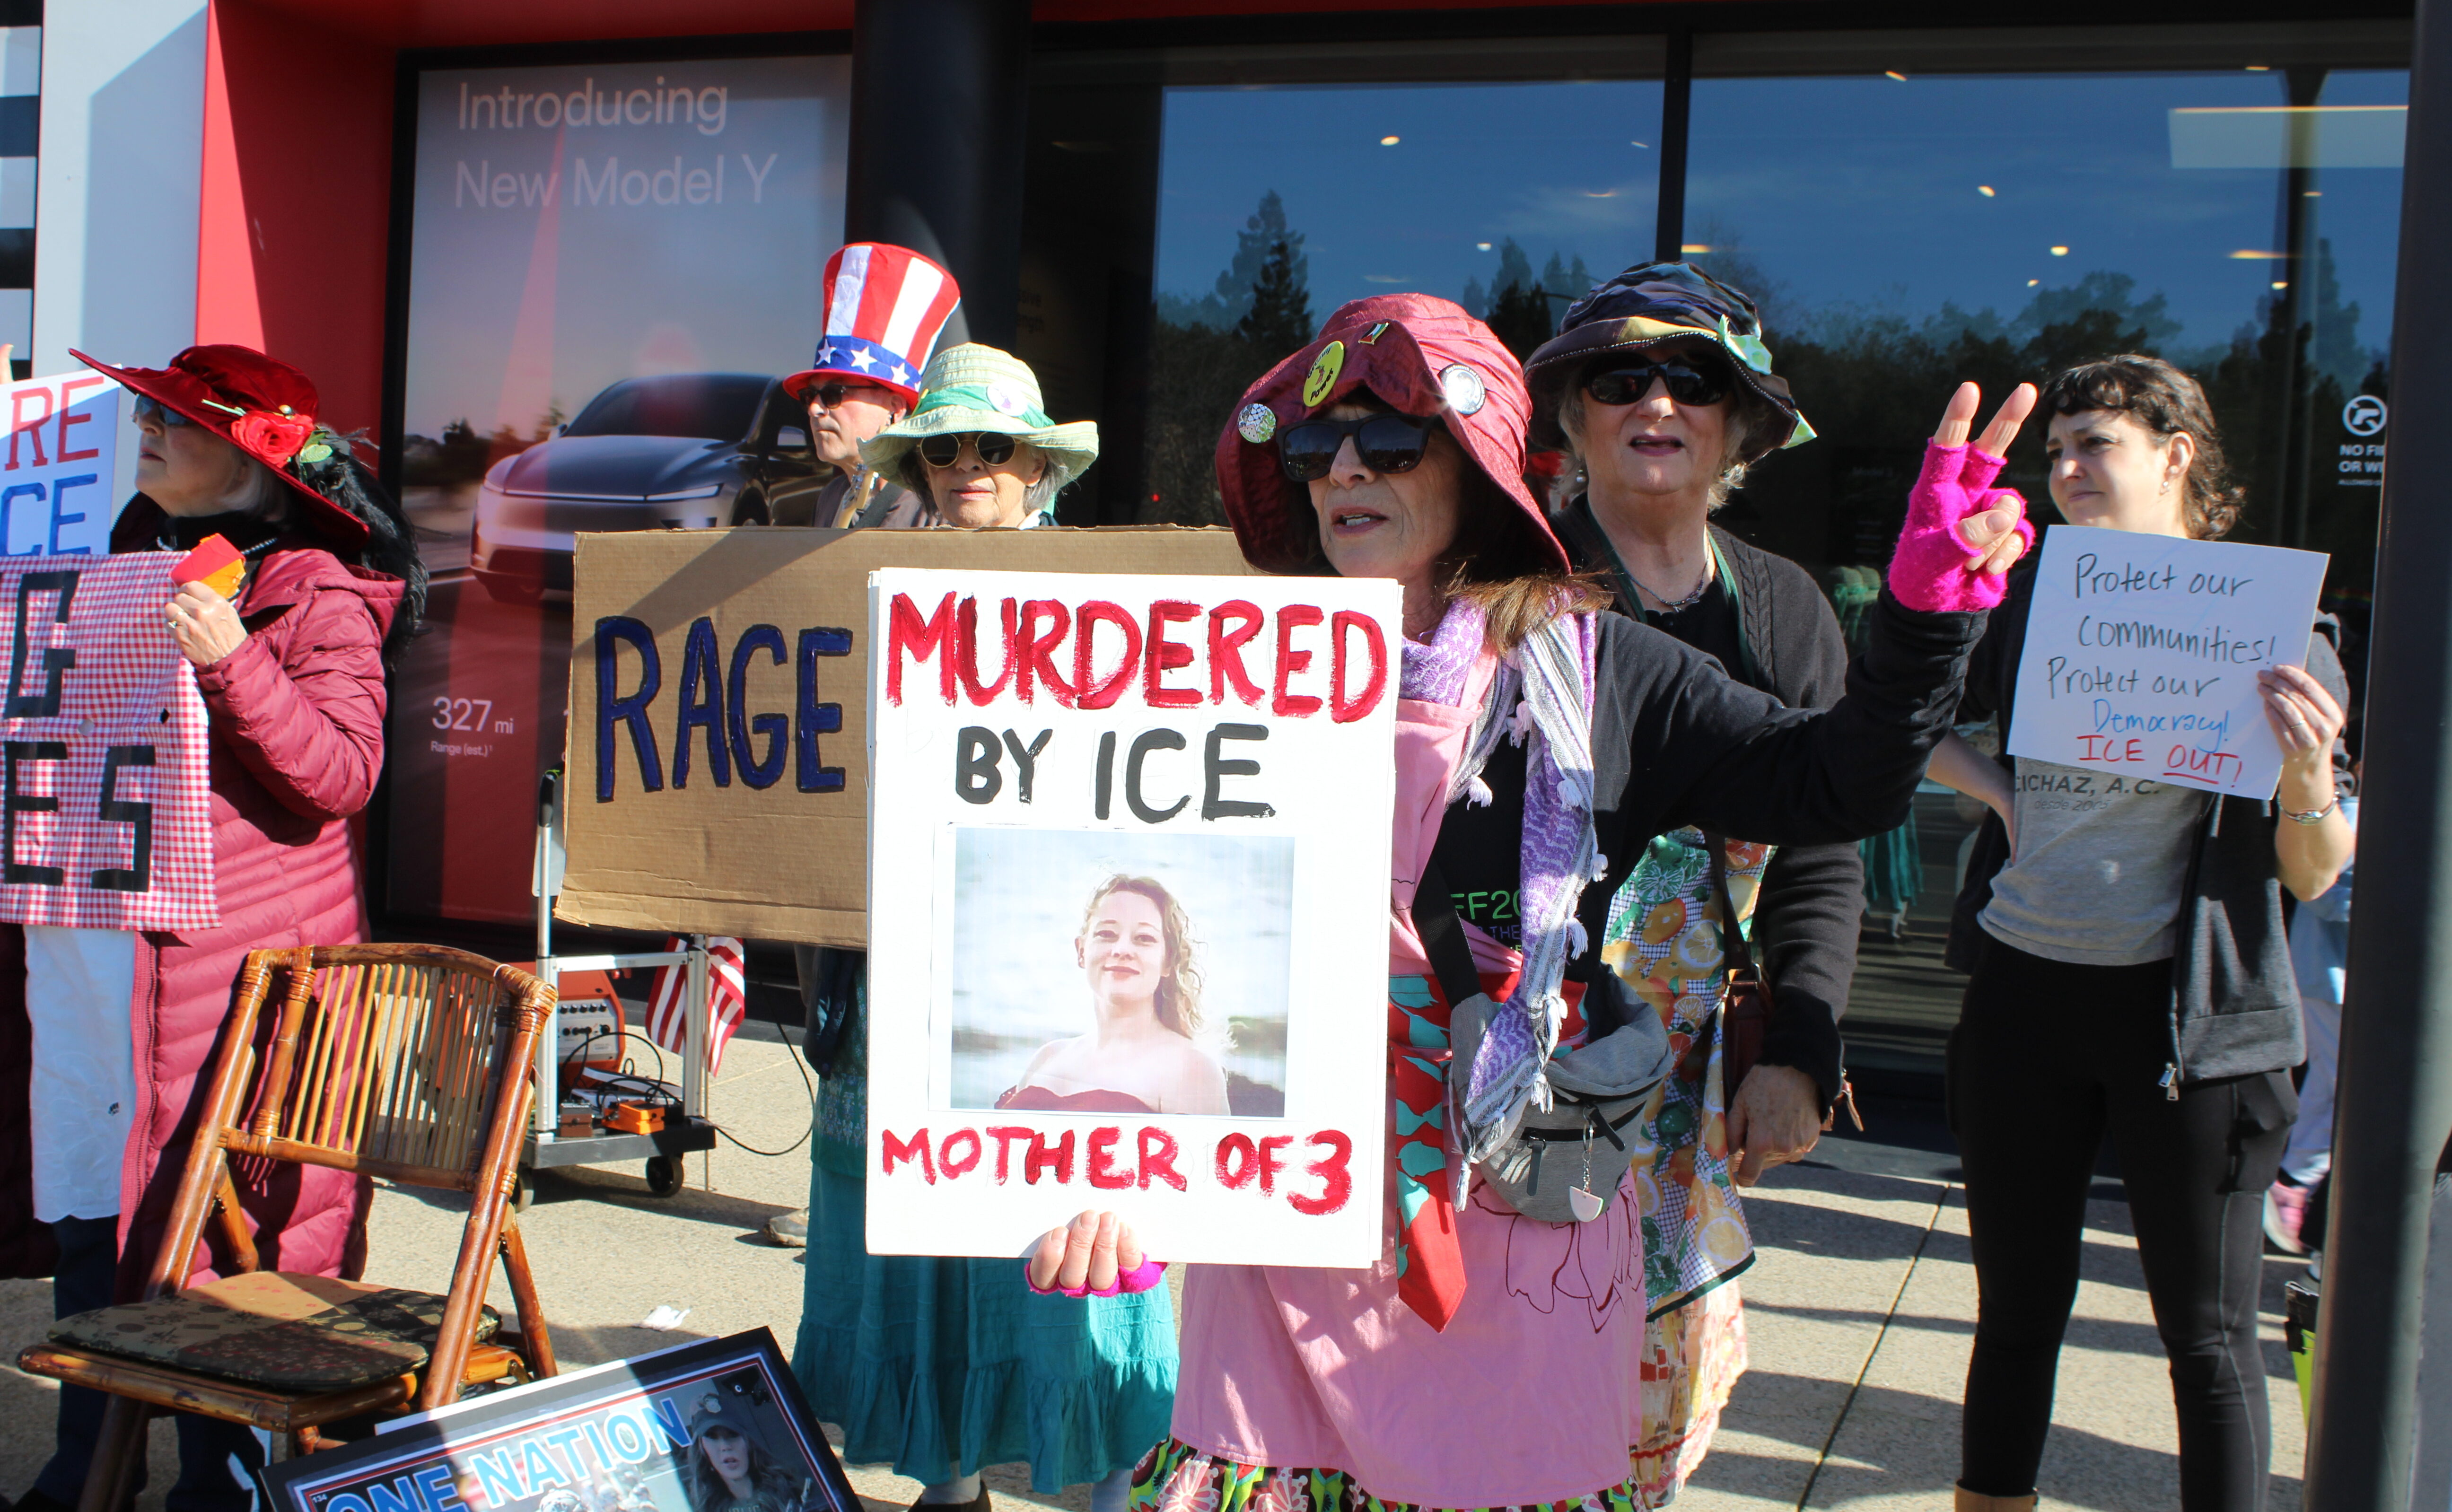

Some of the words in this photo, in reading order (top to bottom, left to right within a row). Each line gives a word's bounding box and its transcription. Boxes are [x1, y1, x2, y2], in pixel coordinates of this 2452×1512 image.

[459, 76, 727, 136] Introducing
[455, 159, 559, 208] New
[573, 155, 725, 206] Model
[741, 153, 778, 203] Y
[1310, 367, 1334, 402] Power
[5, 376, 105, 471] RE
[2338, 460, 2362, 472] OR
[2339, 444, 2364, 456] NO
[2075, 553, 2178, 599] Protect
[2189, 573, 2254, 597] our
[885, 590, 1389, 724] MURDERED
[2047, 655, 2139, 699] Protect
[2152, 674, 2221, 698] our
[431, 696, 492, 732] 327
[495, 717, 514, 734] mi
[595, 616, 854, 803] RAGE
[2093, 699, 2229, 754] Democracy!
[430, 740, 462, 757] Range
[955, 725, 1053, 805] BY
[1094, 723, 1277, 824] ICE
[2076, 734, 2146, 762] ICE
[2166, 744, 2243, 788] OUT!
[2034, 799, 2069, 811] desde
[2105, 777, 2160, 795] A.C.
[880, 1125, 1188, 1193] MOTHER
[469, 1397, 694, 1509] NATION
[312, 1493, 328, 1504] 134
